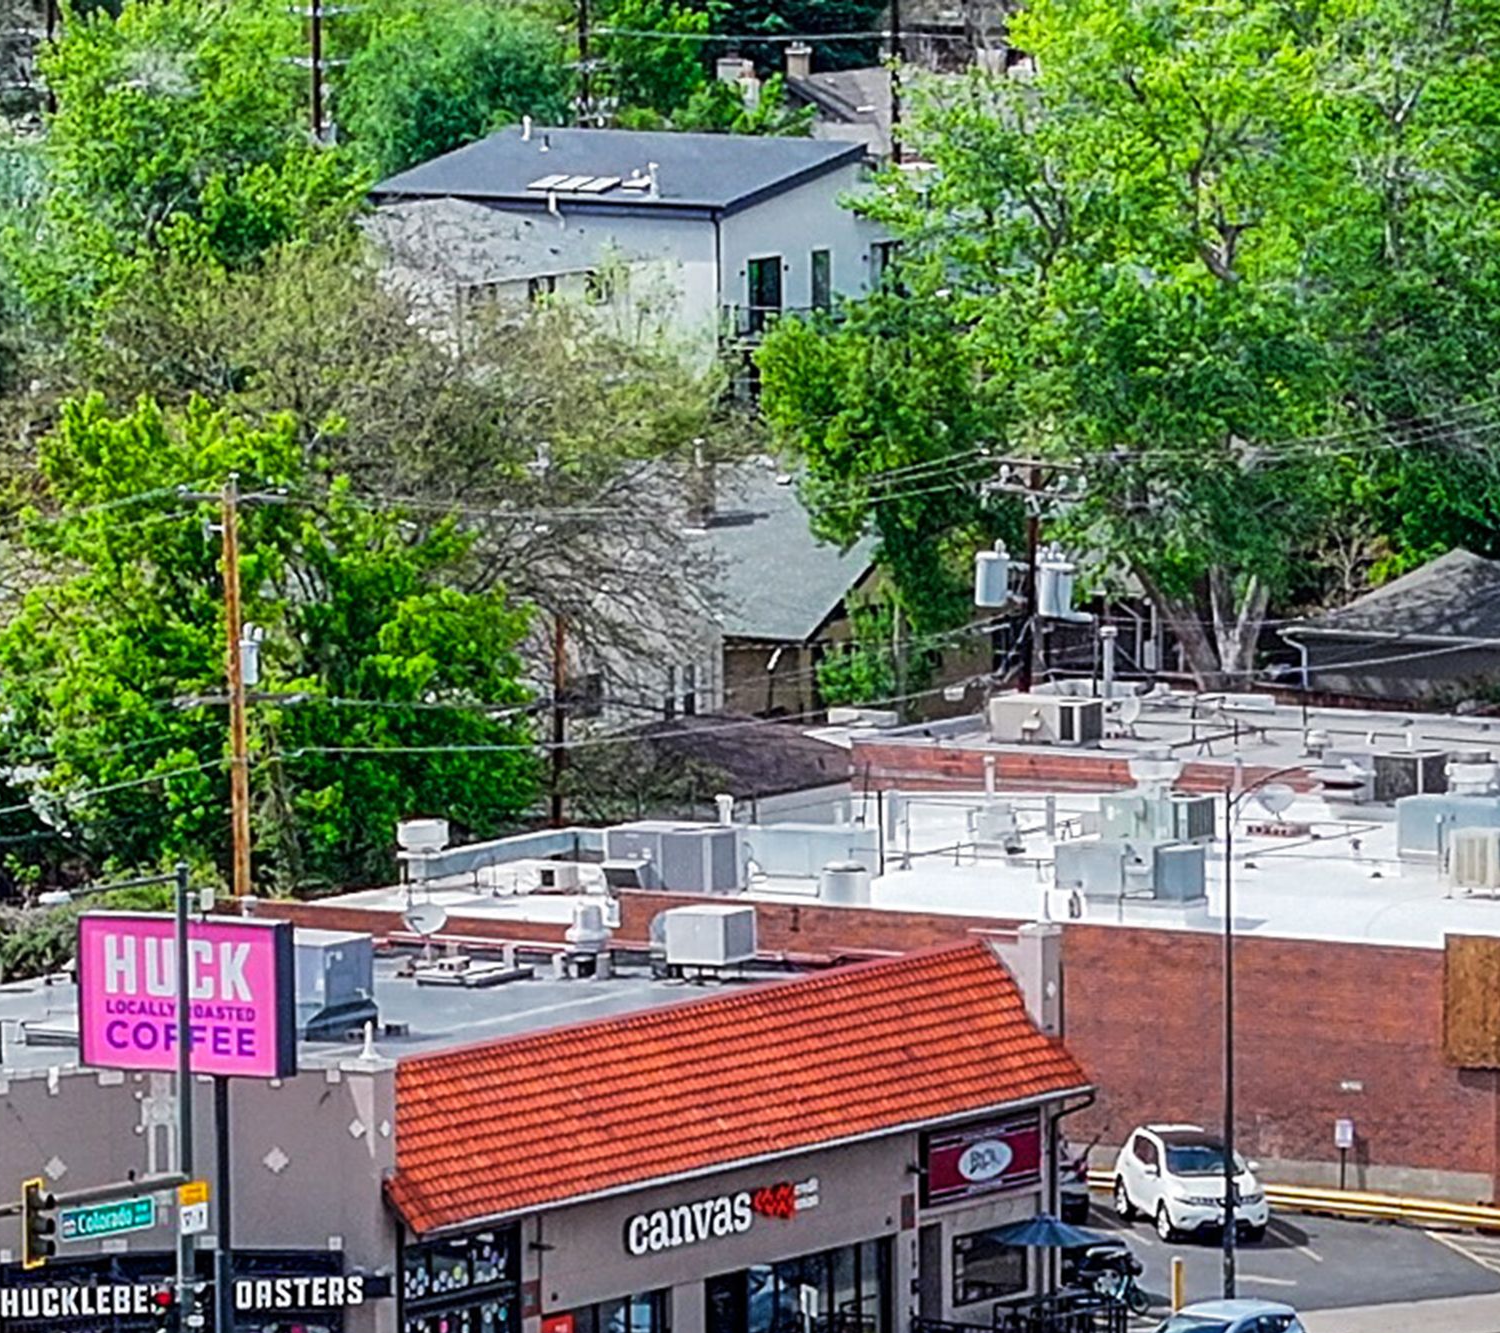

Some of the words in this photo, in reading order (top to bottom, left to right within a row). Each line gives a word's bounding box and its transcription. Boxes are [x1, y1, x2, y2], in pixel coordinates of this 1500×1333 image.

[103, 934, 253, 1002] HUCK
[105, 1000, 176, 1017] LOCALLY
[188, 1002, 256, 1022] OASTED
[106, 1020, 256, 1057] COFFEE
[77, 1206, 133, 1234] Colorado
[628, 1191, 752, 1255] canvas
[0, 1285, 160, 1318] HUCKLEBE
[235, 1276, 365, 1310] OASTERS
